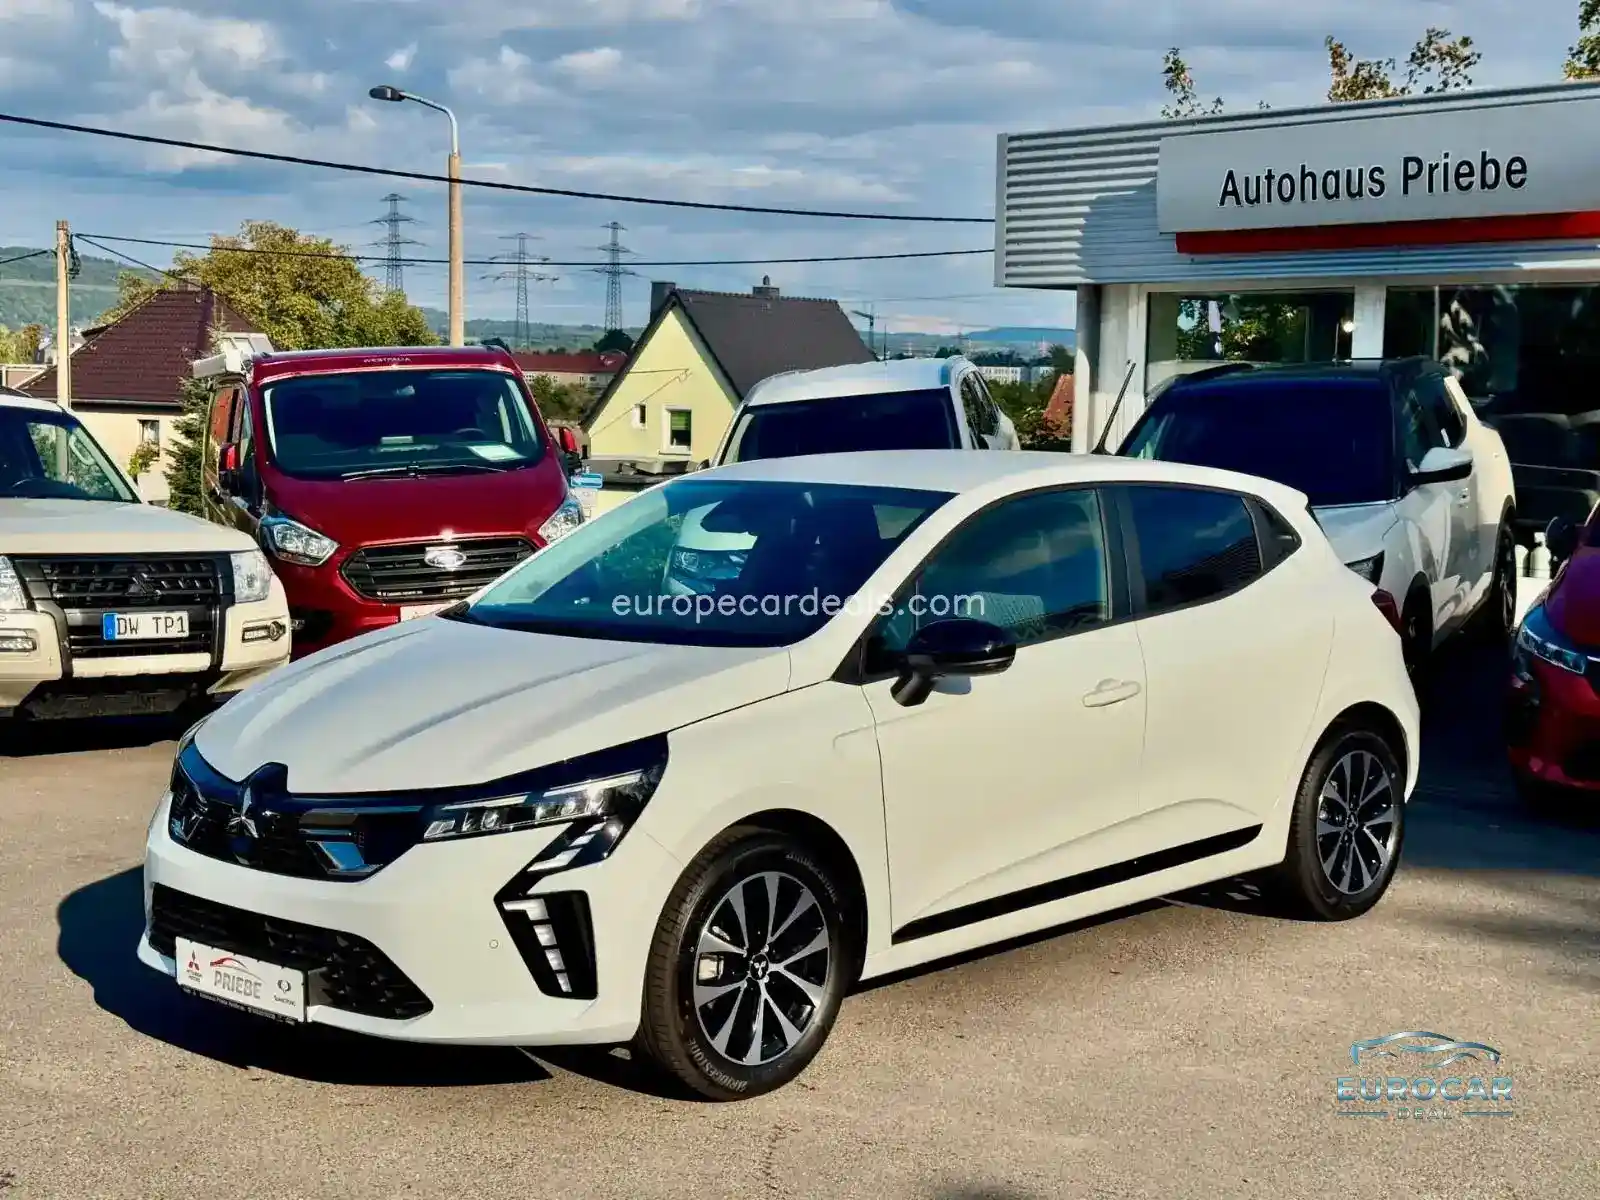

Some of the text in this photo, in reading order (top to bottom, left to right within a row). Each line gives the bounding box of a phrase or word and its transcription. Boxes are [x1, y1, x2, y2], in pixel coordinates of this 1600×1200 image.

[1218, 150, 1527, 207] Autohaus Priebe
[116, 615, 186, 635] DW TP1
[214, 970, 262, 999] PRIEBE
